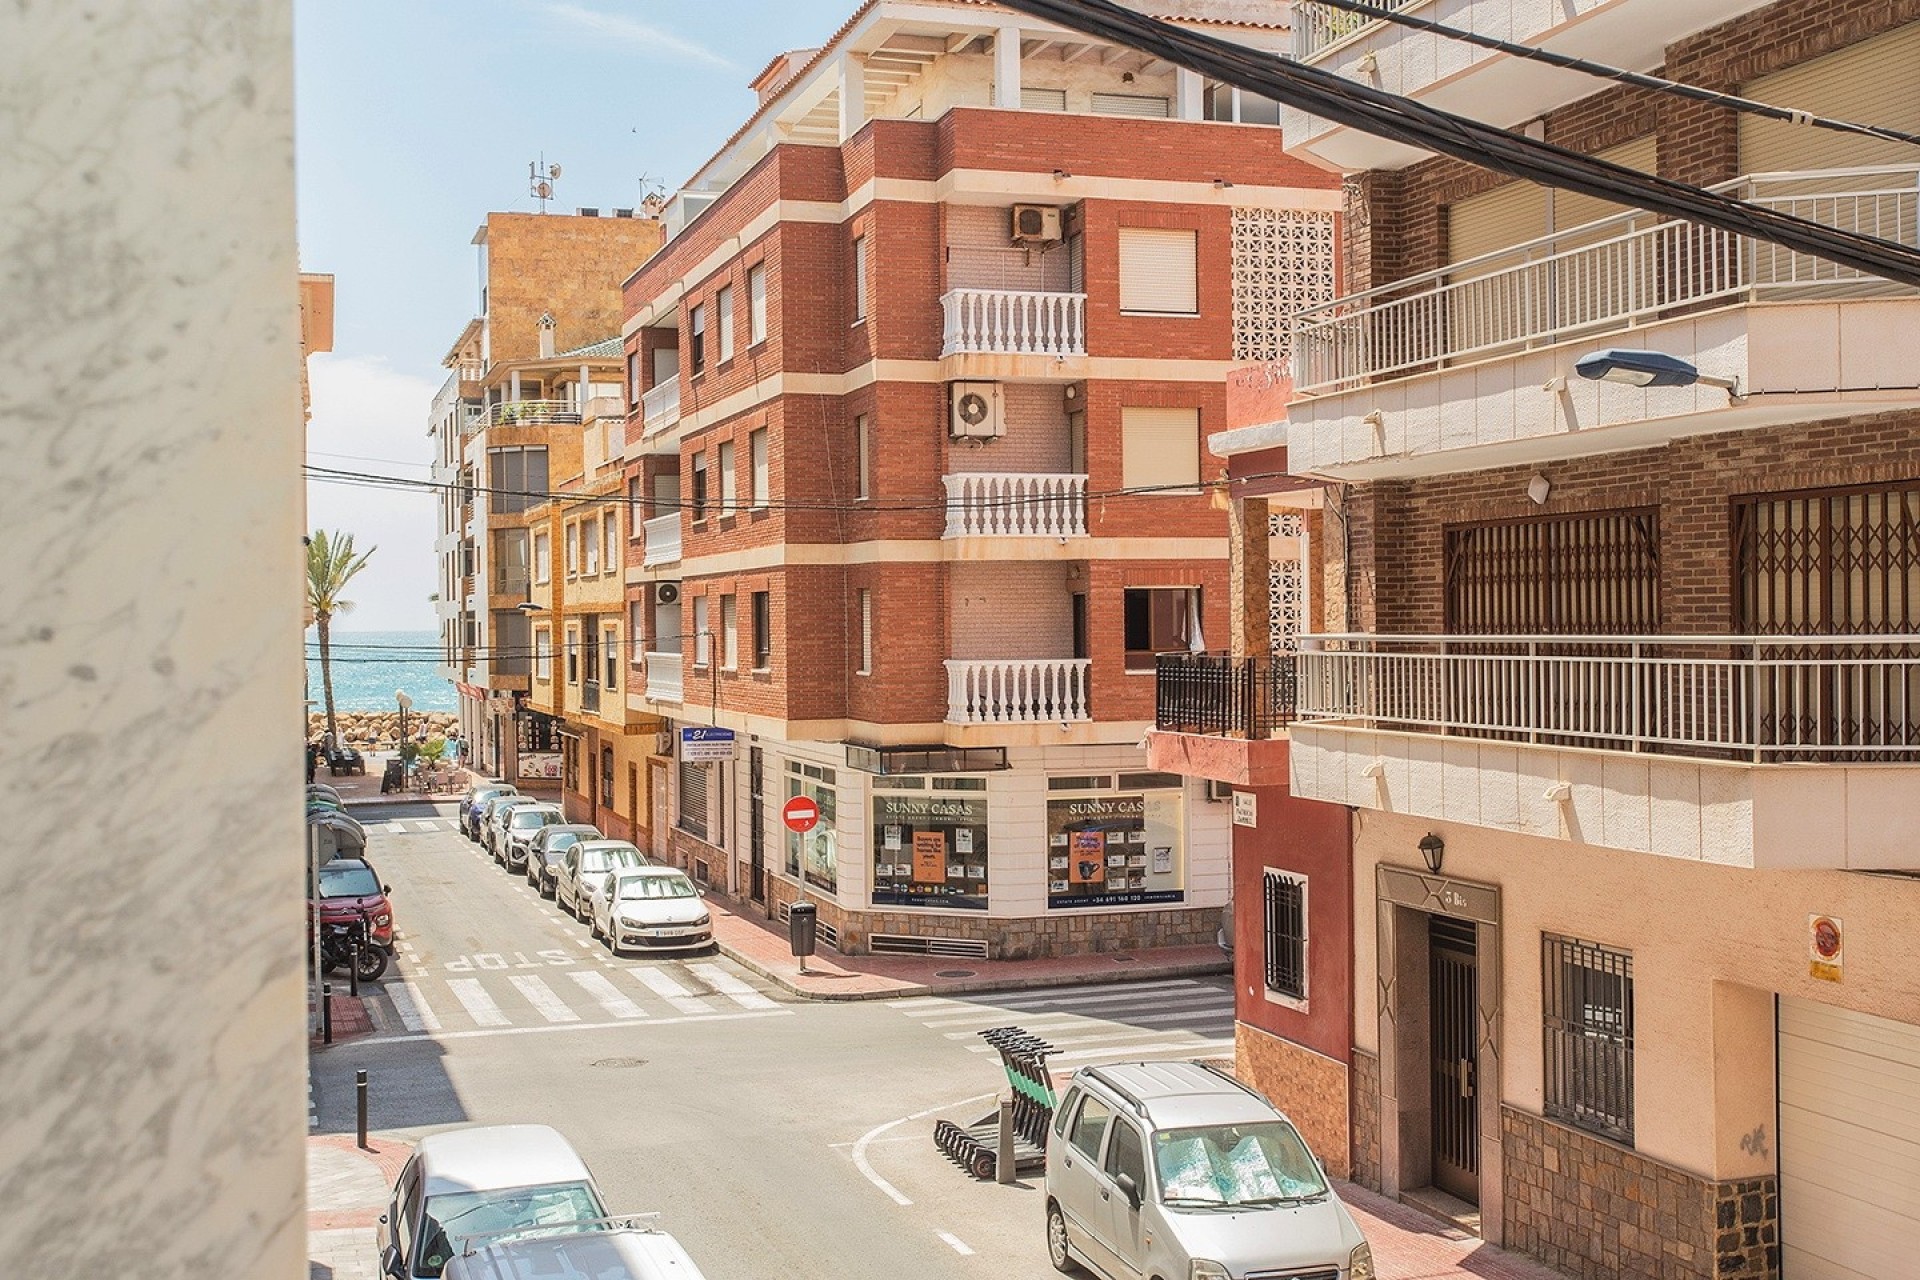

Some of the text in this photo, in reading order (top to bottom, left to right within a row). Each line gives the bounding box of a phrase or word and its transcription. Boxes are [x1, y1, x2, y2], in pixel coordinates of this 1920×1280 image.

[692, 730, 707, 740] 21
[886, 802, 973, 816] SUNNY CASAS
[1069, 802, 1116, 815] SUNNY
[443, 949, 576, 972] STOP
